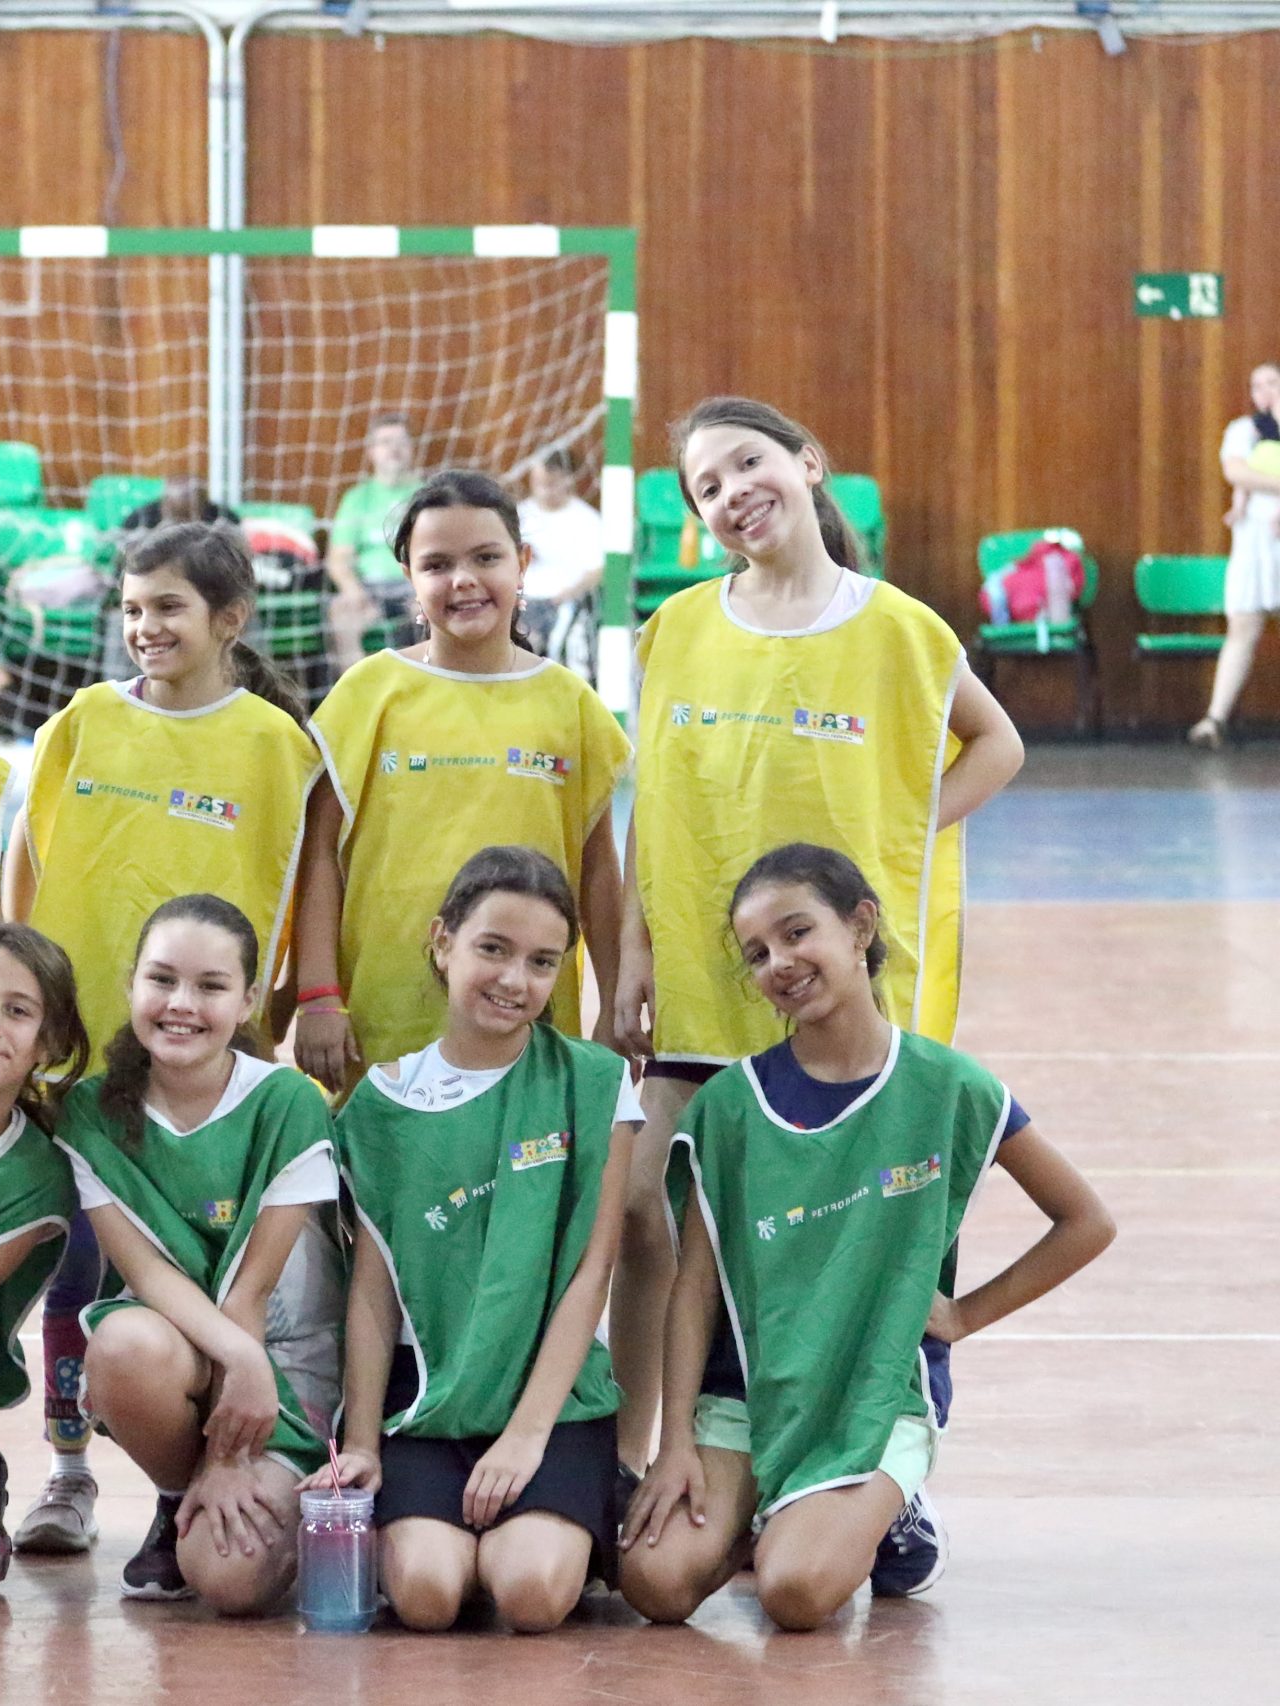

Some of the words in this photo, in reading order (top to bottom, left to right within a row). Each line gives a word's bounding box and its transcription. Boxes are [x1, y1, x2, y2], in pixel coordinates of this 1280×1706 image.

[721, 712, 783, 725] PETROBRAS
[432, 756, 496, 767] PETROBRAS
[97, 784, 159, 803] PETROBRAS
[811, 1186, 869, 1217] PETROBRAS
